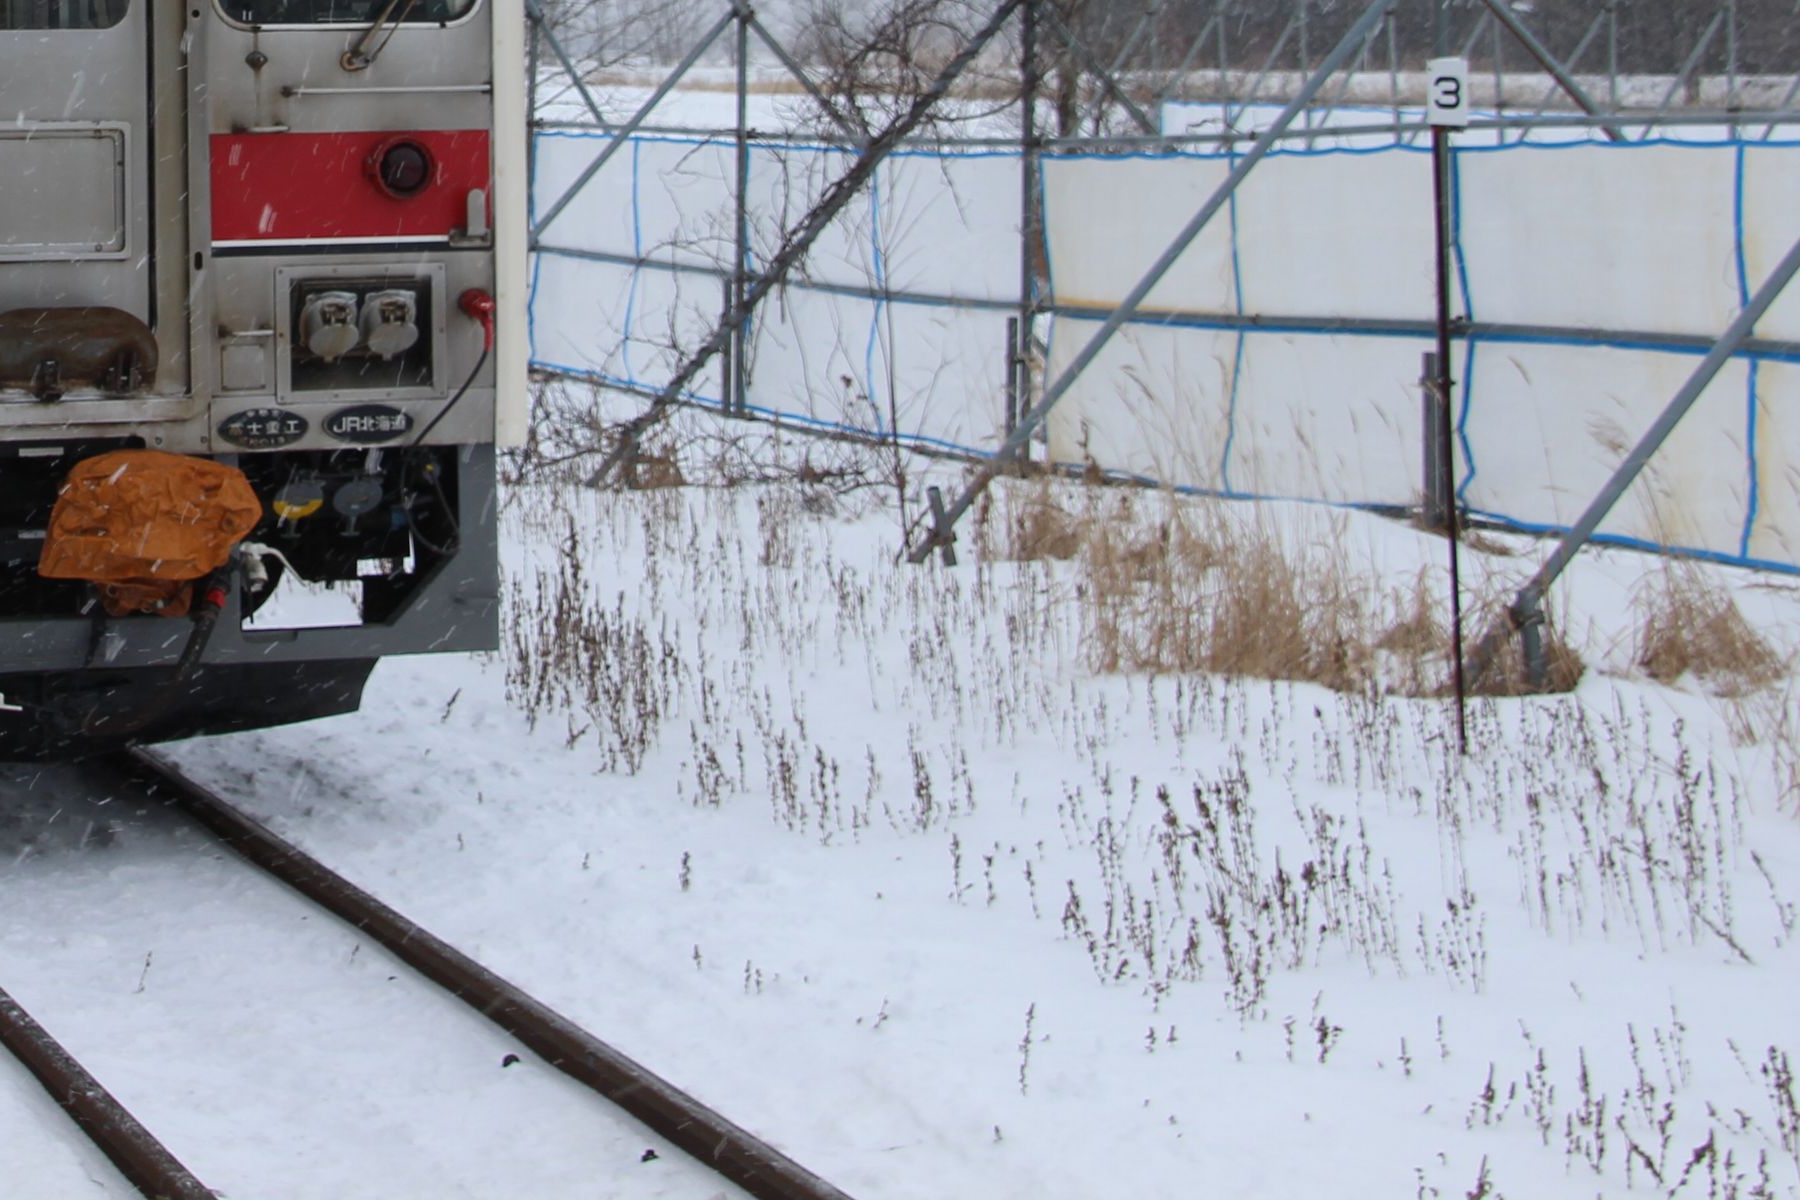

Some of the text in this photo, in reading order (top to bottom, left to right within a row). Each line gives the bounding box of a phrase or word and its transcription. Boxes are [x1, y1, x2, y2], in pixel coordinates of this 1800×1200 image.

[1433, 76, 1461, 109] 3
[333, 414, 407, 433] JR北海道
